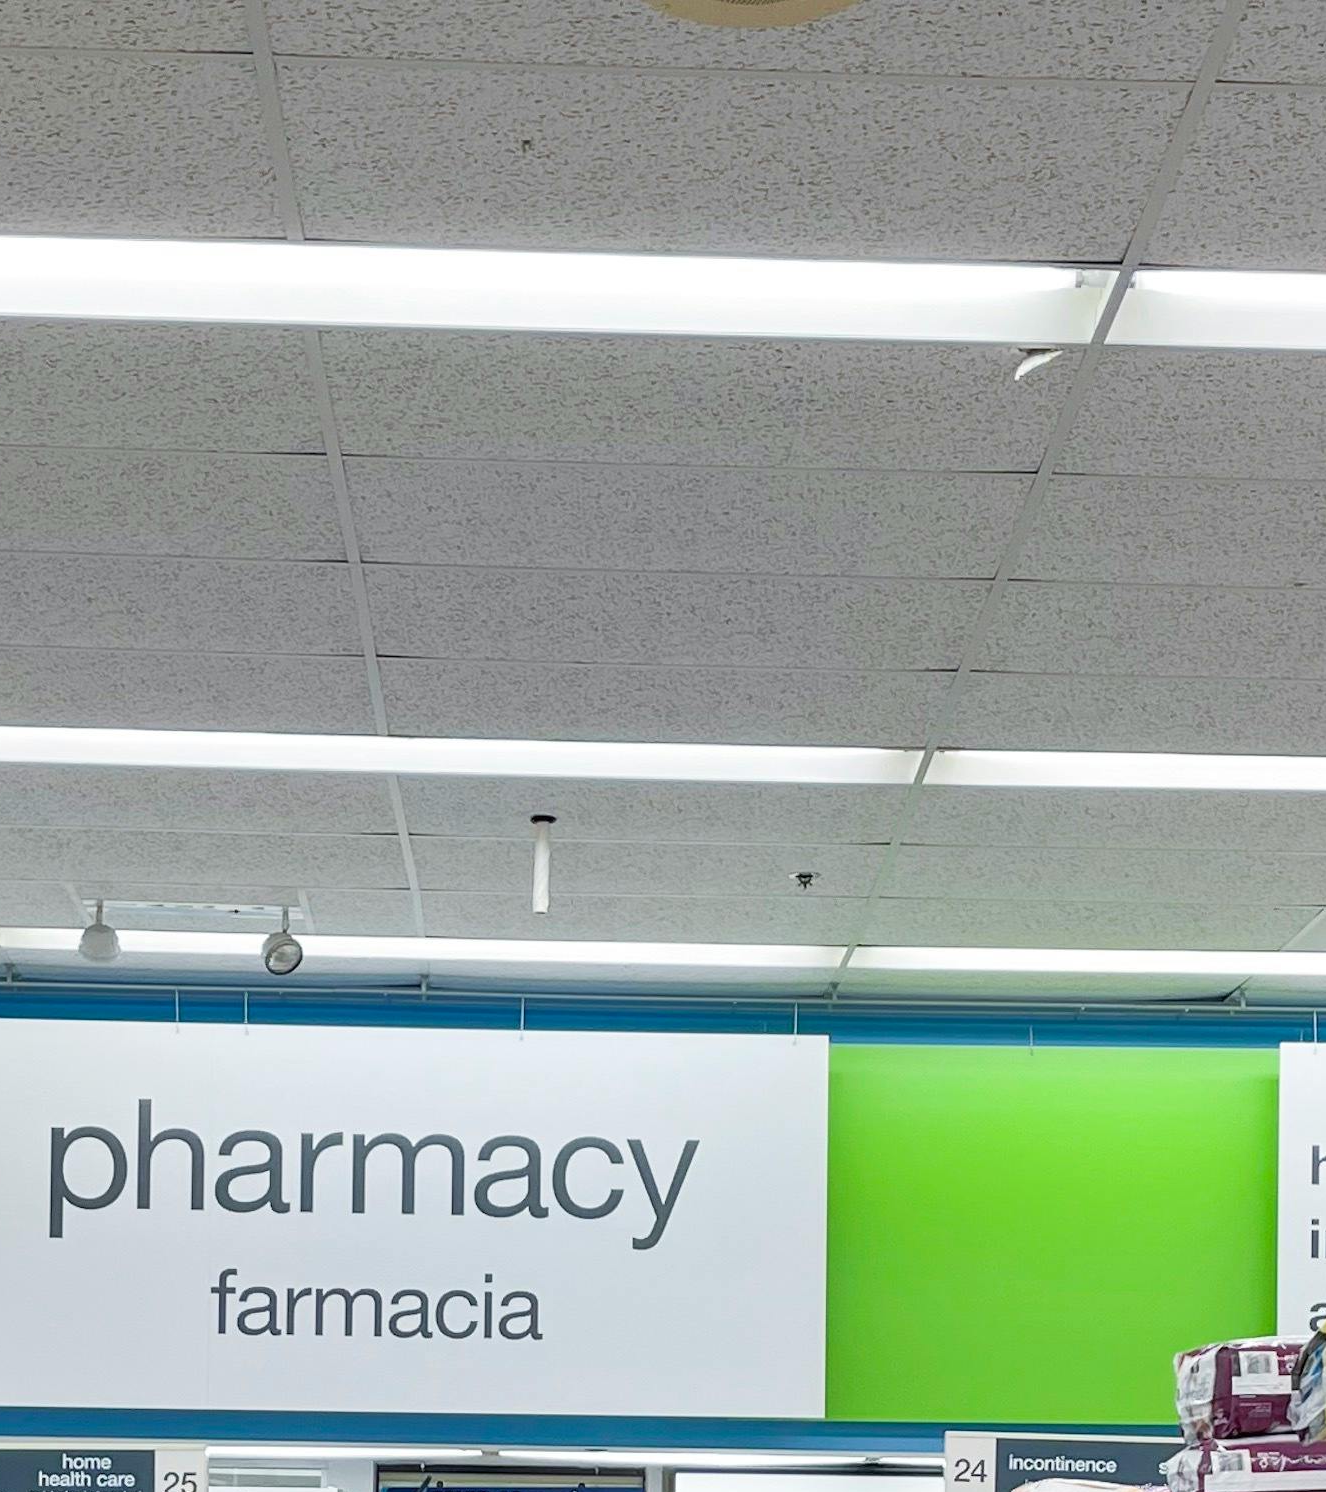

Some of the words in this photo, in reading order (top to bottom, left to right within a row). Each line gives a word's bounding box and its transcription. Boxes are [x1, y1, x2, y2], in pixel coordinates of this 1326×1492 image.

[50, 1099, 699, 1250] pharmacy
[211, 1268, 542, 1342] farmacia
[62, 1454, 112, 1471] home
[953, 1459, 988, 1483] 24
[1008, 1454, 1117, 1475] incontinence
[38, 1471, 95, 1488] health
[98, 1474, 136, 1488] care
